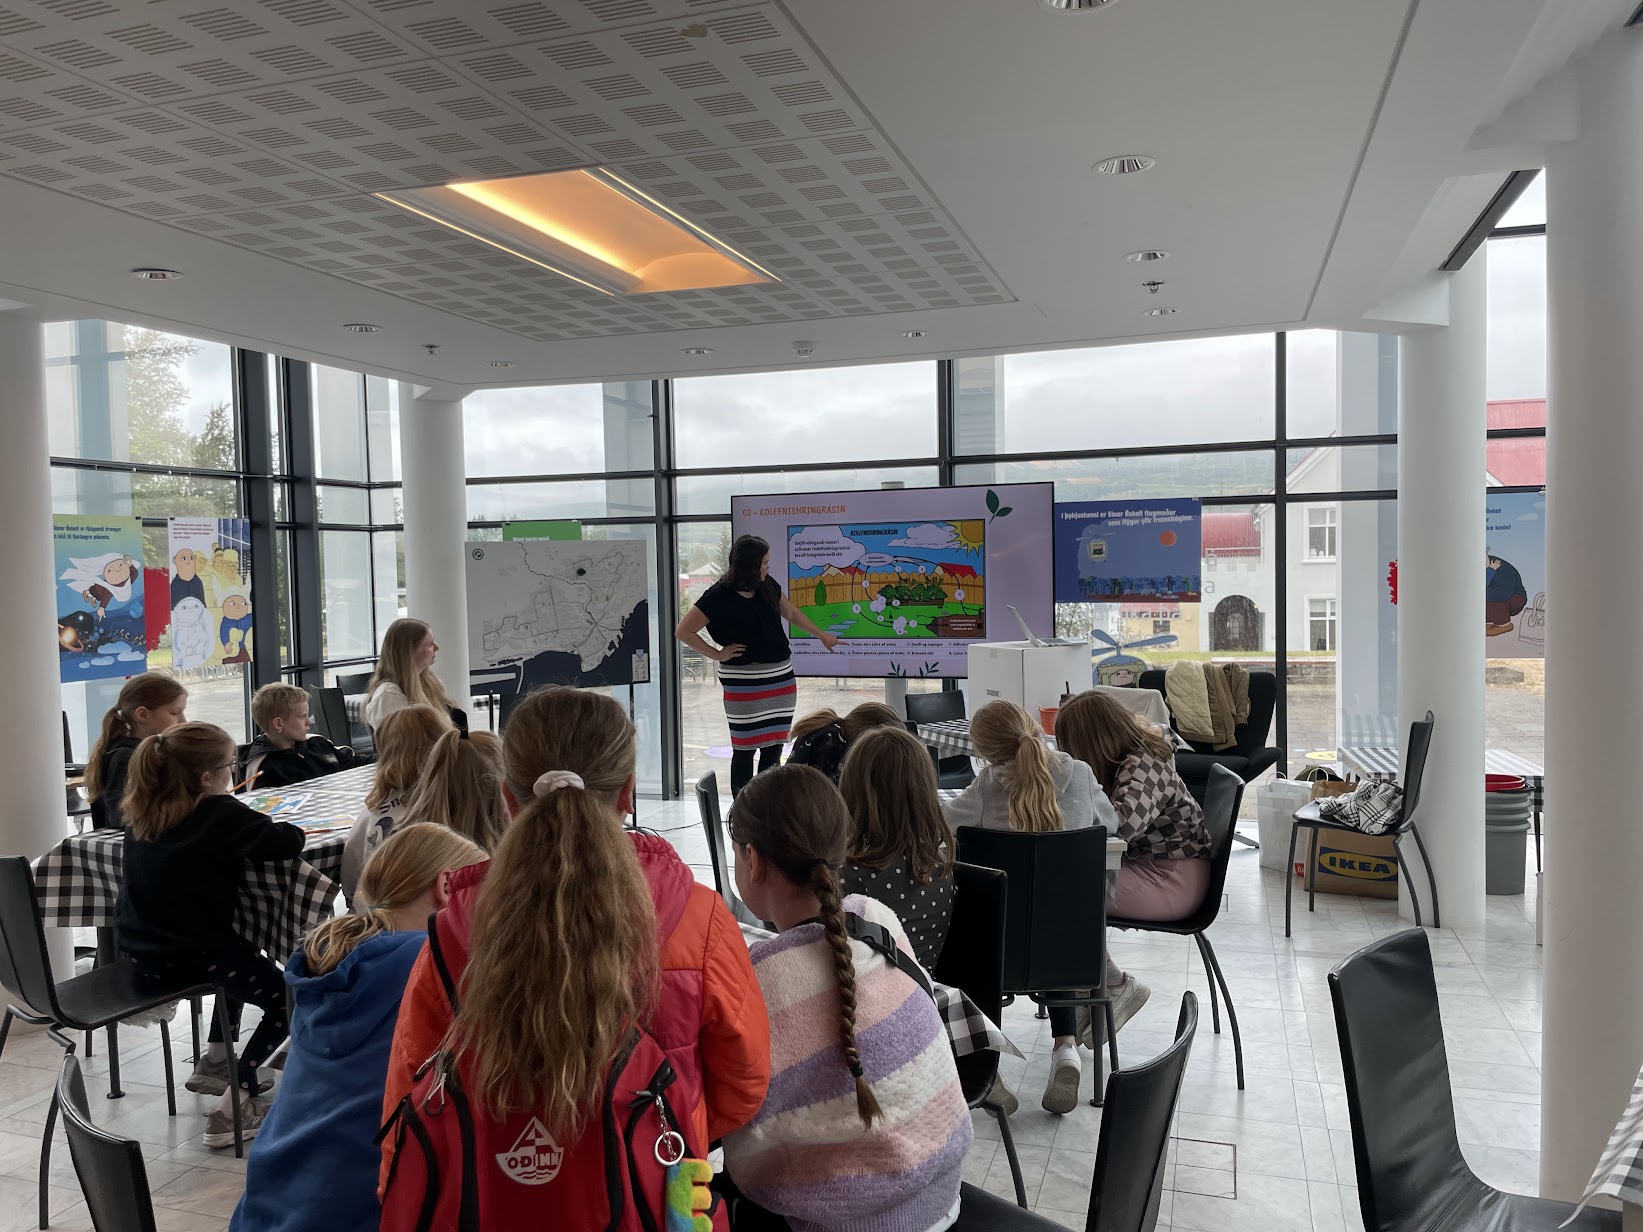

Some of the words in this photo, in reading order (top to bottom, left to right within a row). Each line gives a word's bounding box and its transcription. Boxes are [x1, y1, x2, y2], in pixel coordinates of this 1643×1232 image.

[742, 508, 752, 517] 02
[759, 503, 846, 516] KOLEFNISHRINGRÁSIN
[1124, 509, 1143, 517] Áskell
[1329, 856, 1391, 874] IKEA
